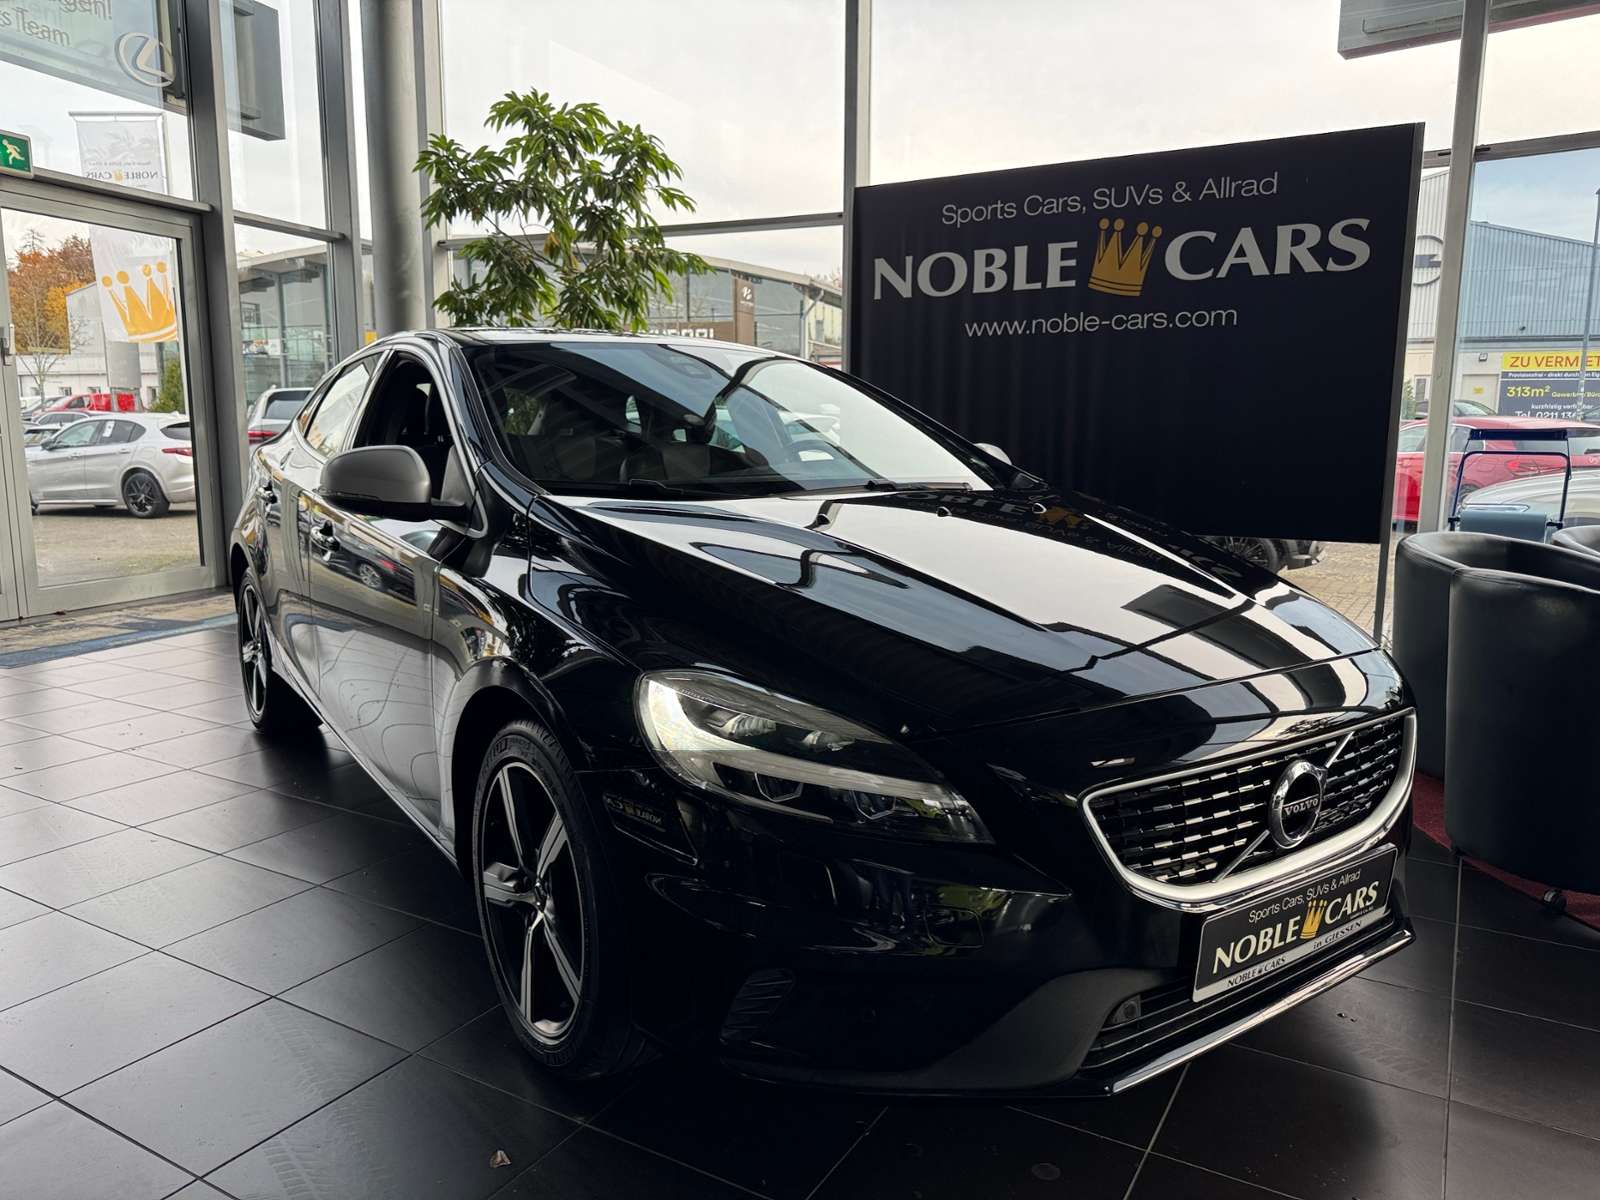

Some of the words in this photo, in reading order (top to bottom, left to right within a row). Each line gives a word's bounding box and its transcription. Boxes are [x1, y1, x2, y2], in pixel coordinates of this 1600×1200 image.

[14, 7, 71, 47] Team
[942, 198, 1016, 228] Sports
[1023, 194, 1087, 216] Cars,
[1092, 184, 1164, 210] SUVs
[1171, 181, 1192, 203] &
[1198, 171, 1278, 201] Allrad
[873, 240, 1078, 300] NOBLE
[1164, 218, 1371, 281] CARS
[964, 308, 1238, 337] www.noble-cars.com
[1509, 356, 1531, 368] ZU
[1284, 798, 1319, 816] VOLVO
[1248, 905, 1280, 924] Sports
[1281, 894, 1306, 911] Cars,
[1306, 884, 1330, 902] SUVs
[1330, 879, 1338, 891] &
[1338, 868, 1361, 889] Allrad
[1212, 915, 1301, 975] NOBLE
[1324, 881, 1380, 924] CARS
[1227, 968, 1257, 988] NOBLE
[1263, 955, 1287, 973] CARS
[1312, 940, 1322, 950] in
[1326, 920, 1363, 944] GIESSEN
